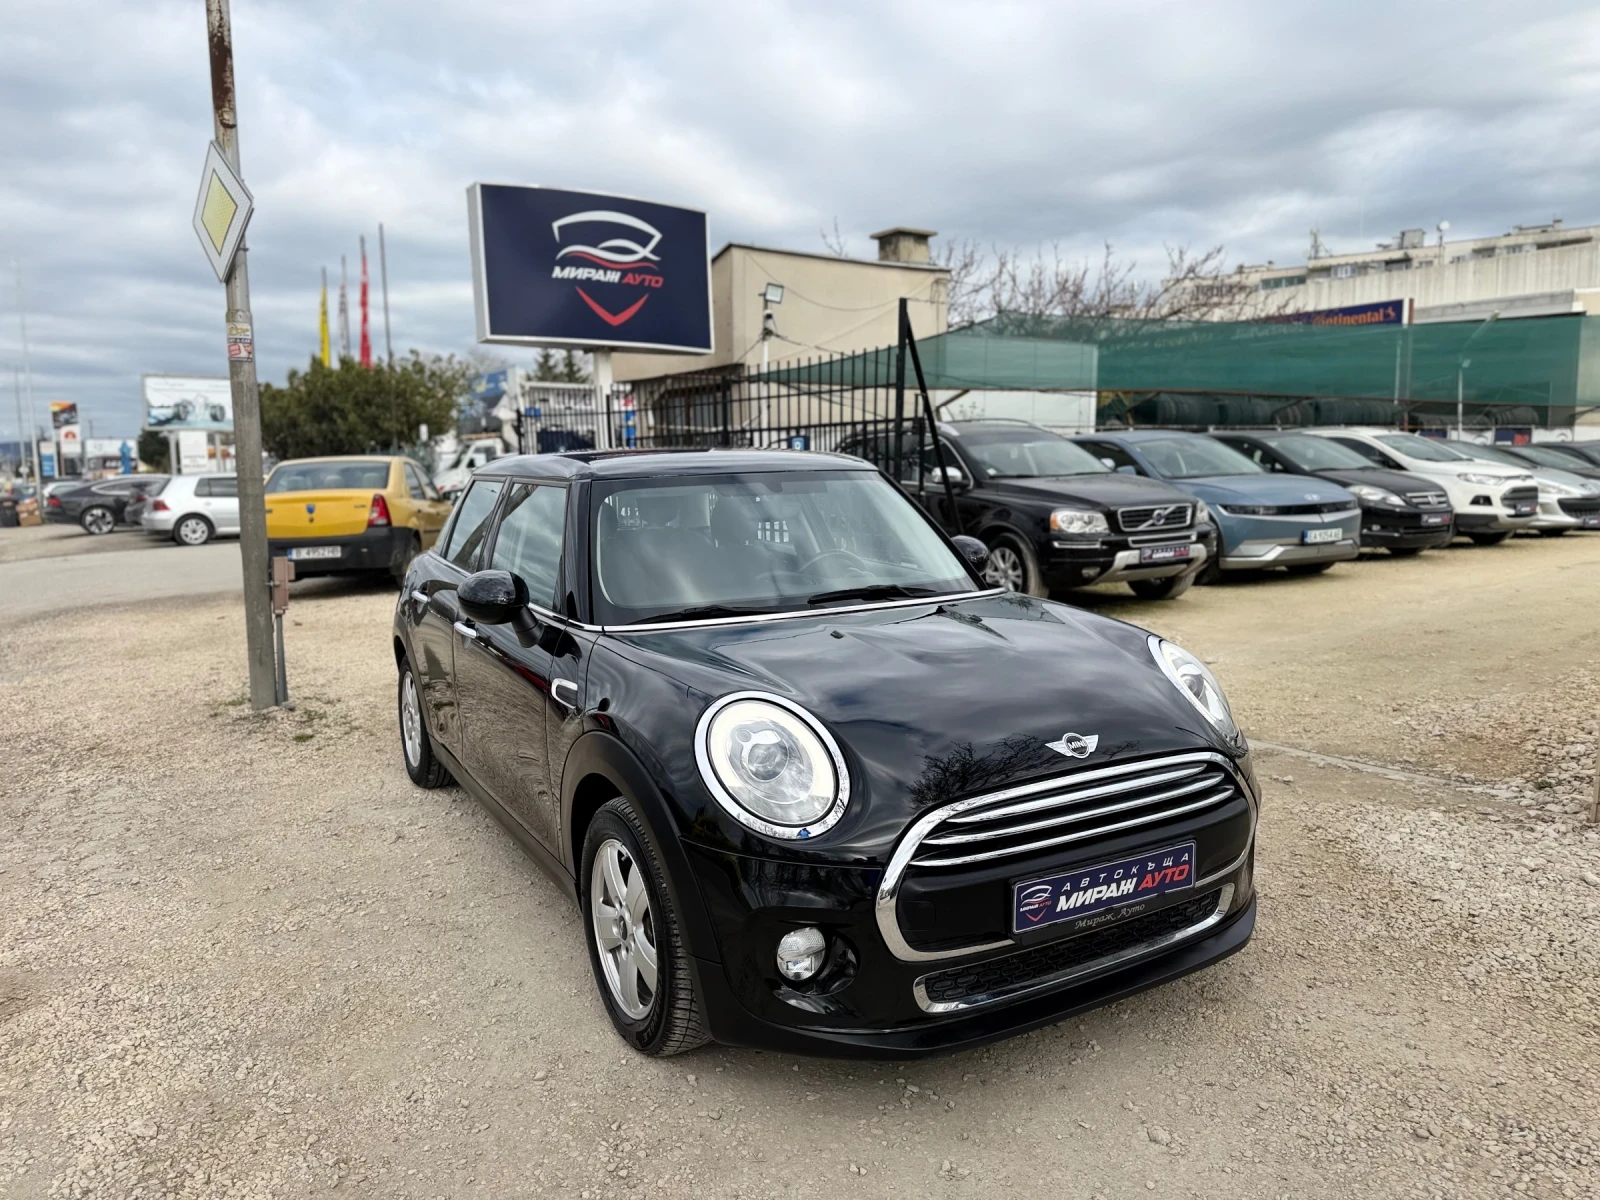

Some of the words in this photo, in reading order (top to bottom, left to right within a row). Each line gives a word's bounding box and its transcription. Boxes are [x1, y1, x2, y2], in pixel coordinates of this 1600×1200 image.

[551, 266, 621, 282] МИРАЖ
[622, 273, 664, 287] АУТО
[1067, 740, 1088, 750] MINI
[1055, 877, 1138, 912] МИРАЖ
[1137, 864, 1190, 891] АУТО
